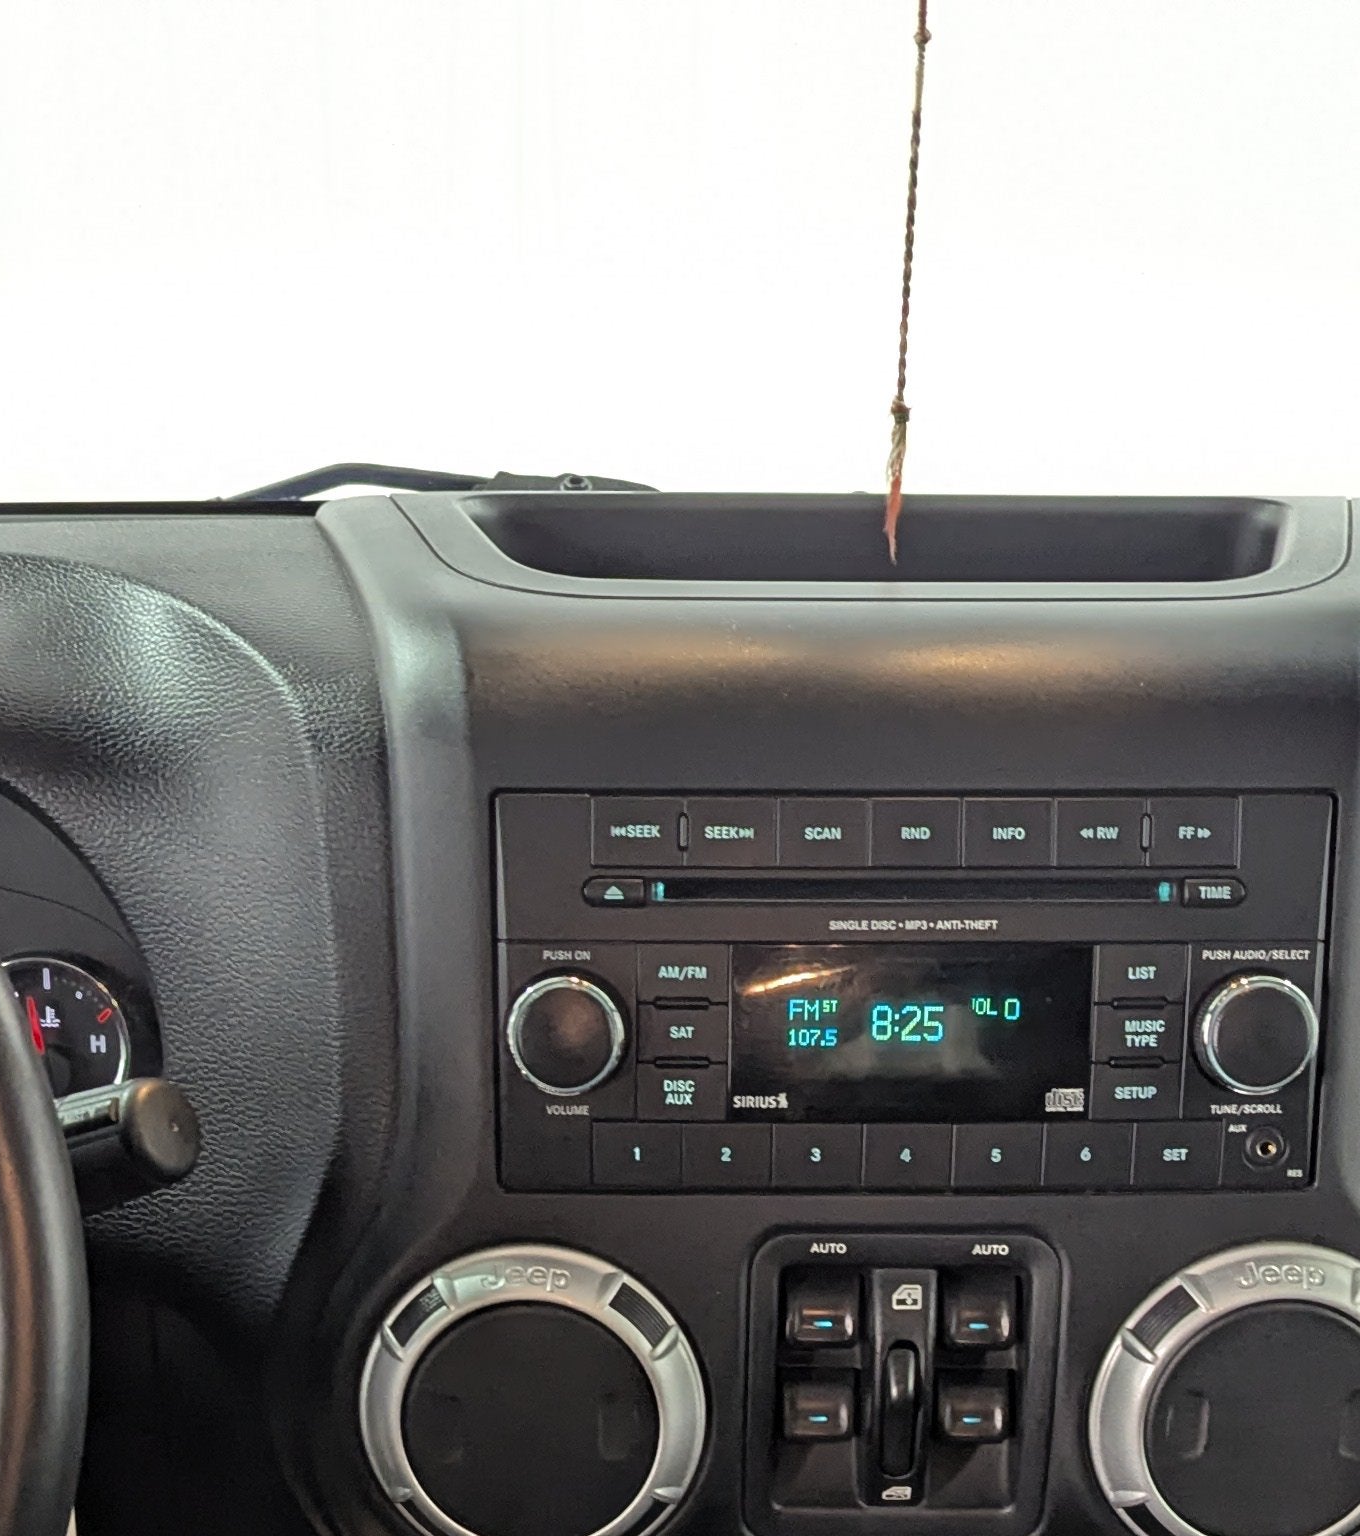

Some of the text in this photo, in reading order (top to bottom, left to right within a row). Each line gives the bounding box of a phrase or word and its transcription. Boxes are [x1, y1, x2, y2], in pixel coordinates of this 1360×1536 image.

[626, 825, 660, 837] SEEK
[705, 826, 738, 838] SEEK
[805, 827, 841, 840] SCAN
[902, 827, 930, 839] RND
[993, 827, 1025, 839] INFO
[1097, 827, 1118, 839] RW
[1179, 827, 1195, 839] FF
[1199, 886, 1230, 899] TIME
[829, 920, 998, 930] SINGLE DISC MP3 ANTI-THEFT
[543, 951, 590, 960] PUSH ON
[1202, 950, 1310, 960] PUSH AUDIO/SELECT
[658, 966, 706, 980] AM/FM
[1128, 966, 1156, 979] LIST
[790, 1000, 819, 1020] FM
[872, 1005, 943, 1041] 8:25
[1125, 1020, 1165, 1032] MUSIC
[670, 1026, 694, 1038] SAT
[789, 1029, 837, 1046] 107.5
[90, 1035, 106, 1053] H
[1126, 1035, 1157, 1047] TYPE
[664, 1080, 694, 1092] DISC
[666, 1093, 692, 1104] AUX
[1115, 1086, 1157, 1099] SETUP
[733, 1095, 778, 1109] SIRIUS
[546, 1105, 589, 1115] VOLUME
[1211, 1104, 1282, 1115] TUNE/SCROLL
[634, 1147, 640, 1160] 1
[721, 1148, 731, 1161] 2
[811, 1148, 821, 1161] 3
[900, 1149, 911, 1162] 4
[991, 1149, 1001, 1162] 5
[1081, 1147, 1091, 1161] 6
[1163, 1149, 1188, 1161] SET
[811, 1243, 846, 1253] AUTO
[972, 1245, 1009, 1255] AUTO
[480, 1264, 572, 1293] Jeep
[1234, 1262, 1325, 1290] Jeep
